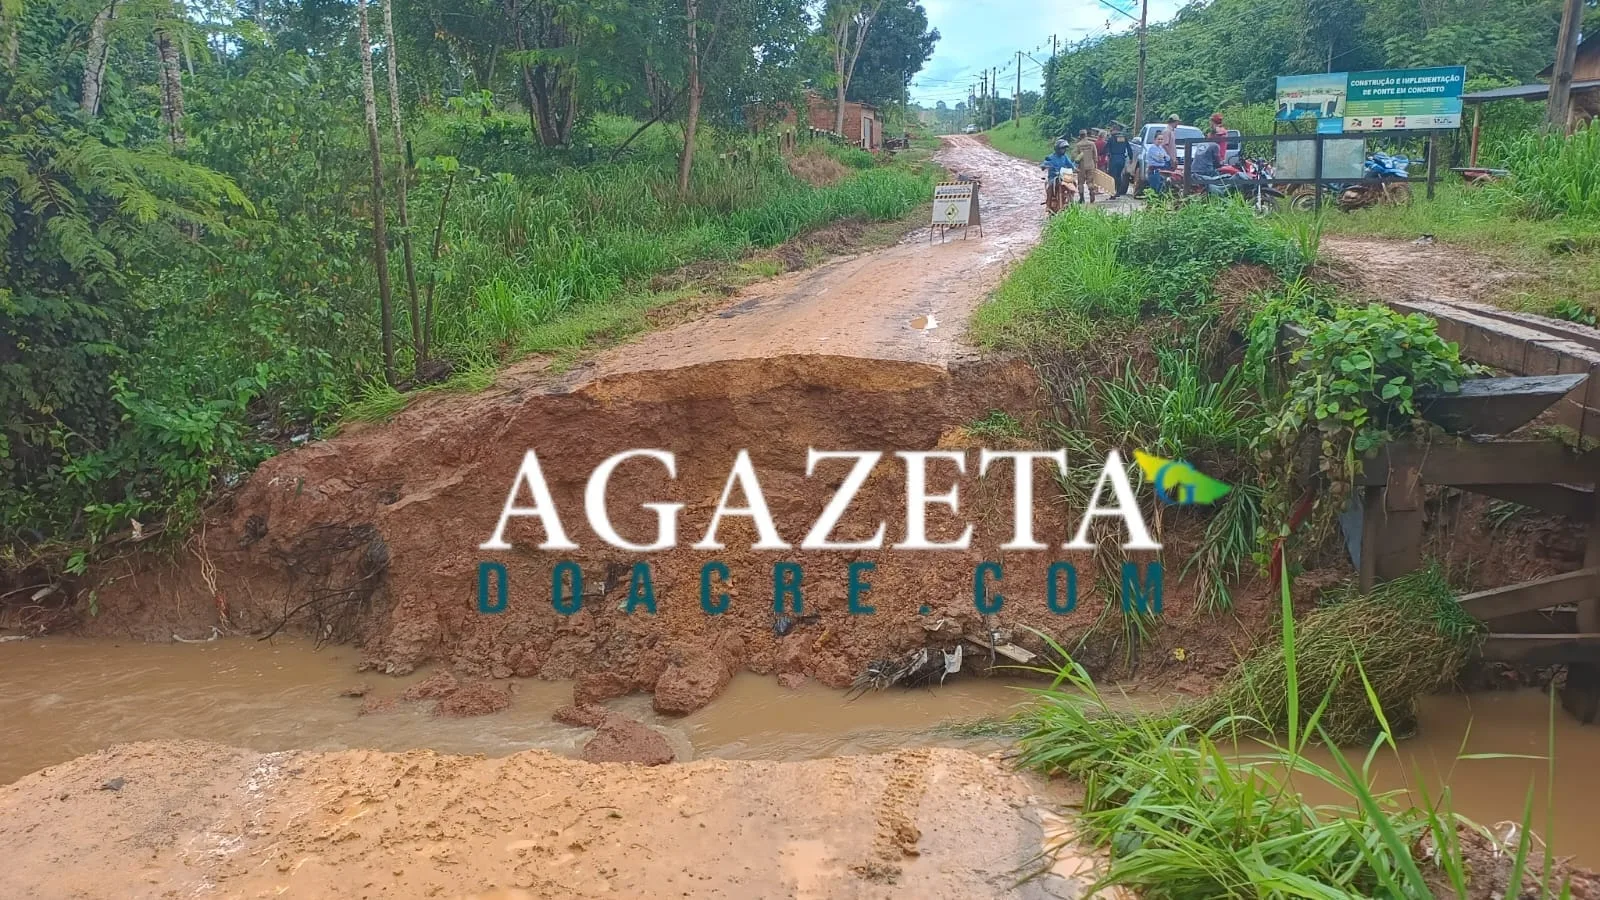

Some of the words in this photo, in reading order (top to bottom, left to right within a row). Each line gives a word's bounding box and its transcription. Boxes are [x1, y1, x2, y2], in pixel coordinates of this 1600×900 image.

[1350, 77, 1395, 87] CONSTRUÇÃO
[1401, 74, 1460, 85] IMPLEMENTAÇÃO
[1373, 88, 1395, 96] PONTE
[1407, 85, 1445, 94] CONCRETO
